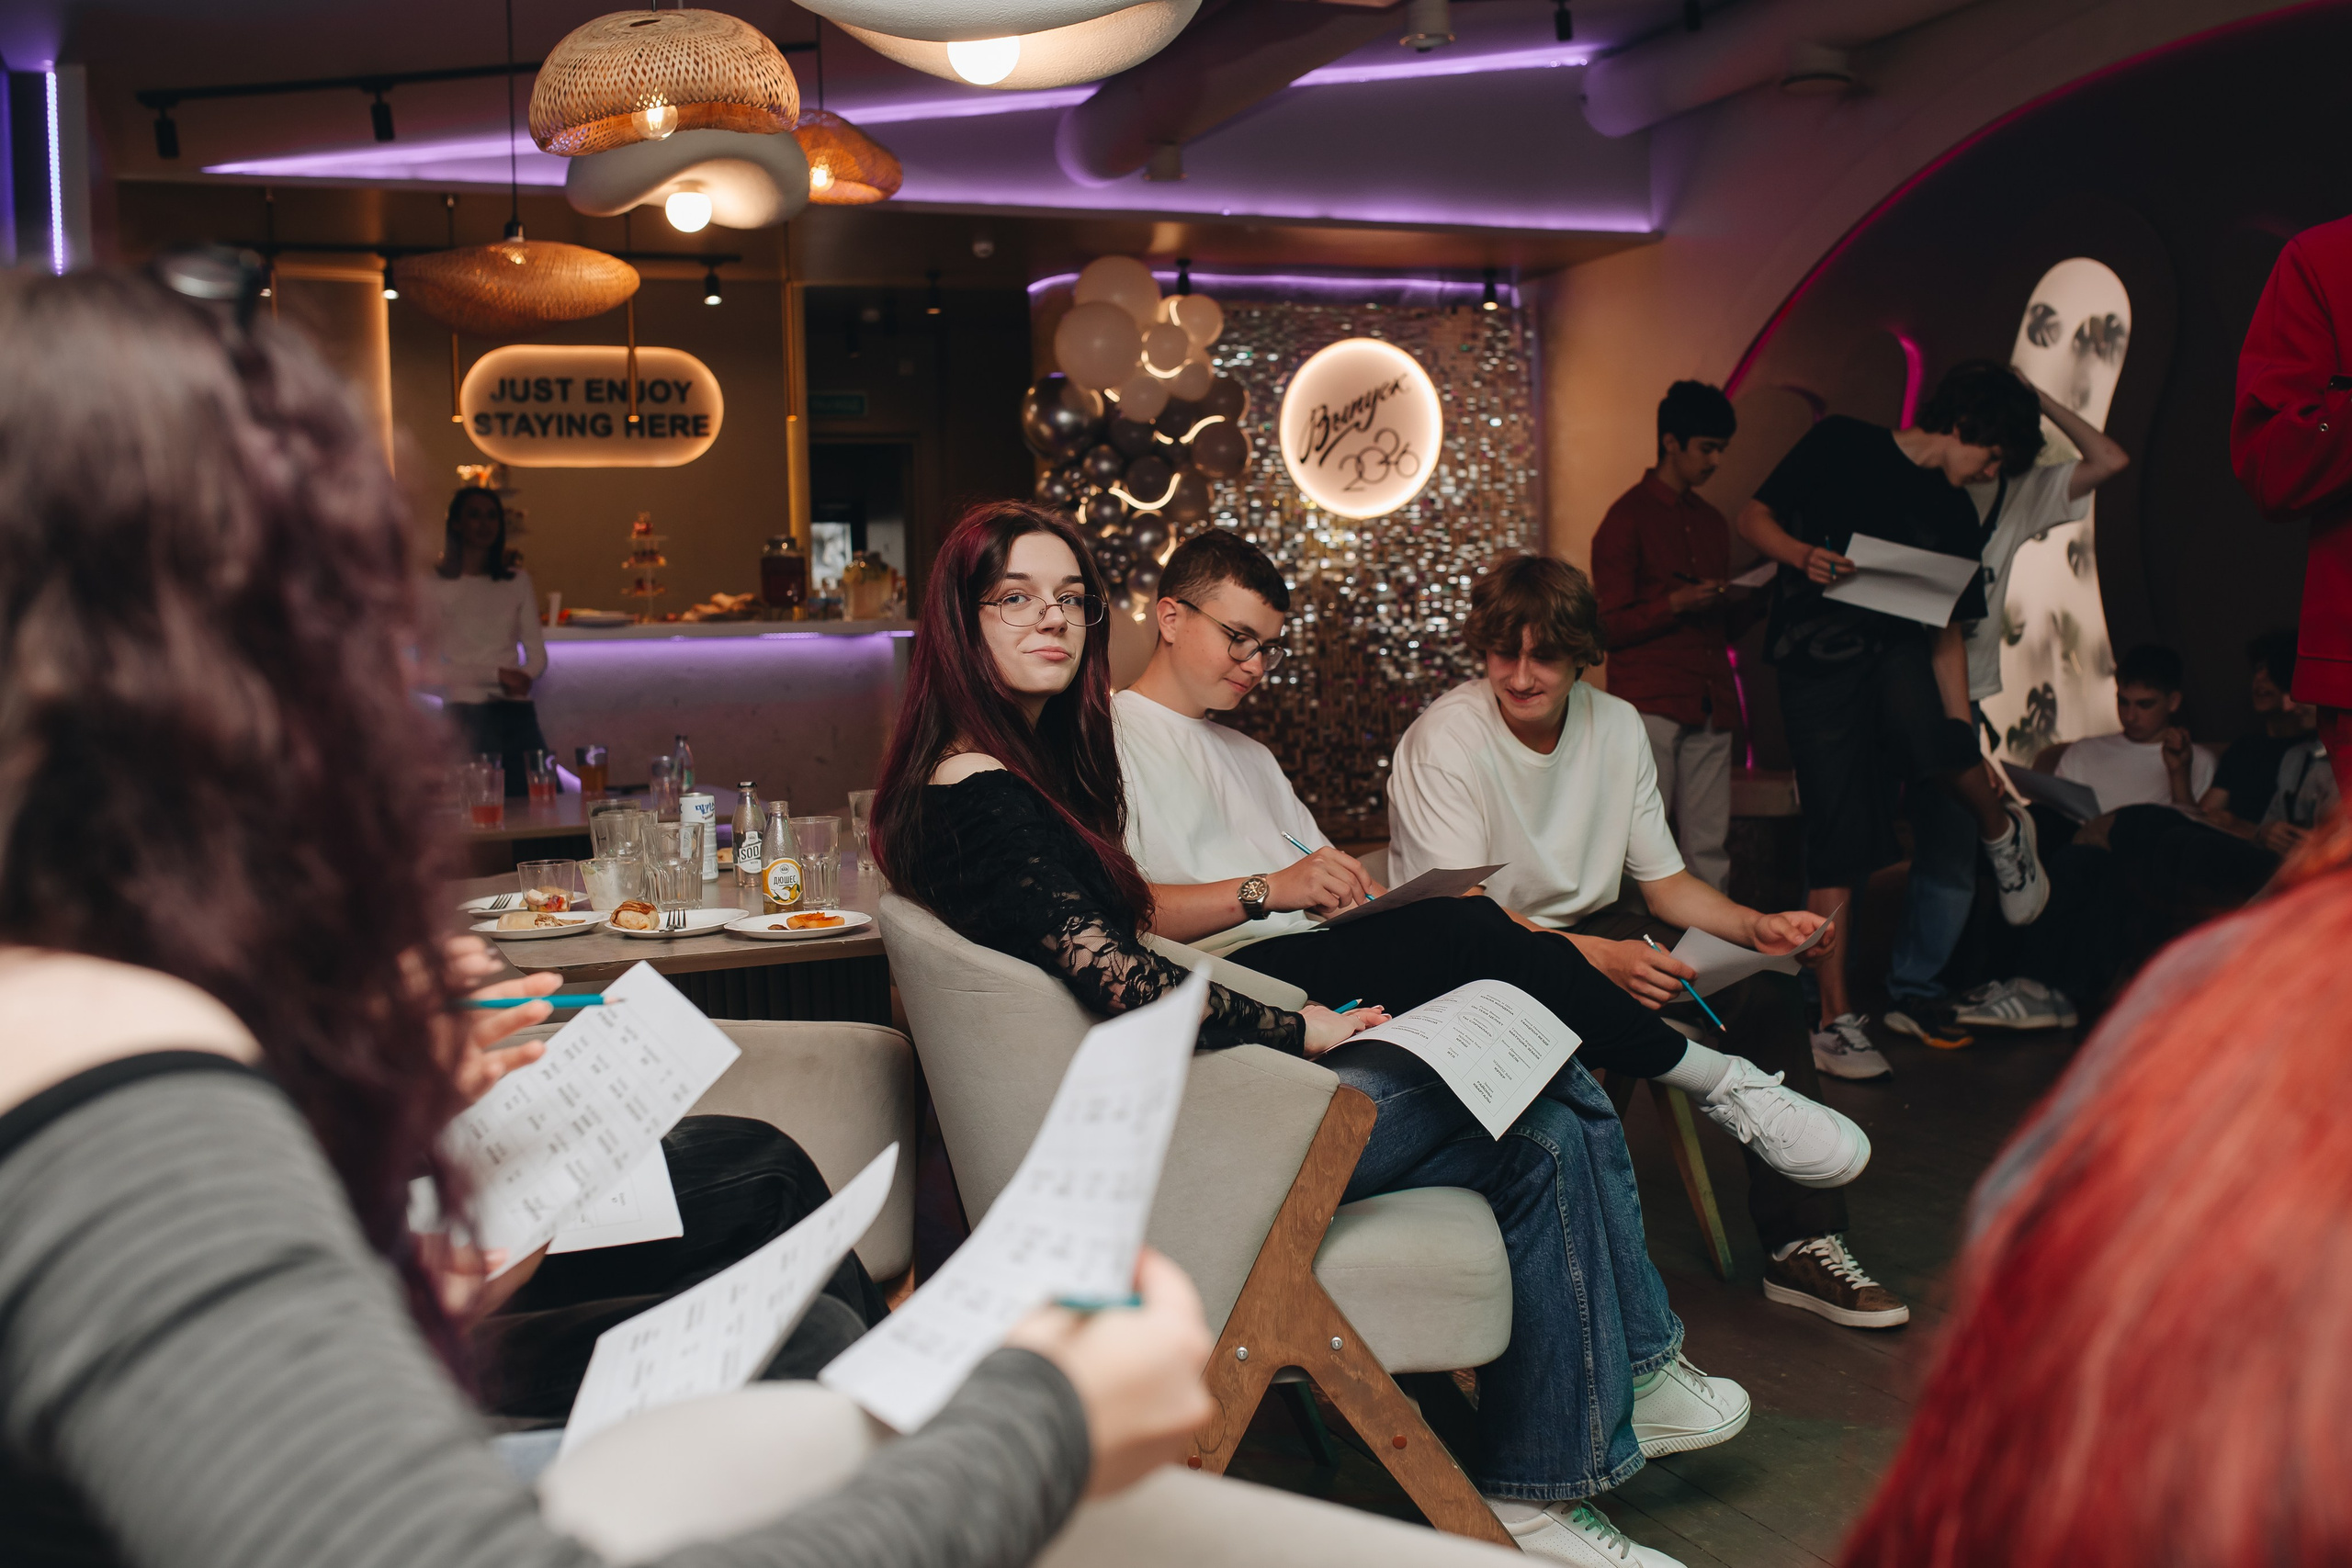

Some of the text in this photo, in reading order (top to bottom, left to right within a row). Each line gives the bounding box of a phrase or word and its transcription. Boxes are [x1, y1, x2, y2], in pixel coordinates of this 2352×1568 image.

[490, 378, 692, 403] JUST ENJOY
[474, 412, 710, 438] STAYING HERE
[741, 845, 760, 861] SOD
[774, 874, 797, 886] ДЮШЕС
